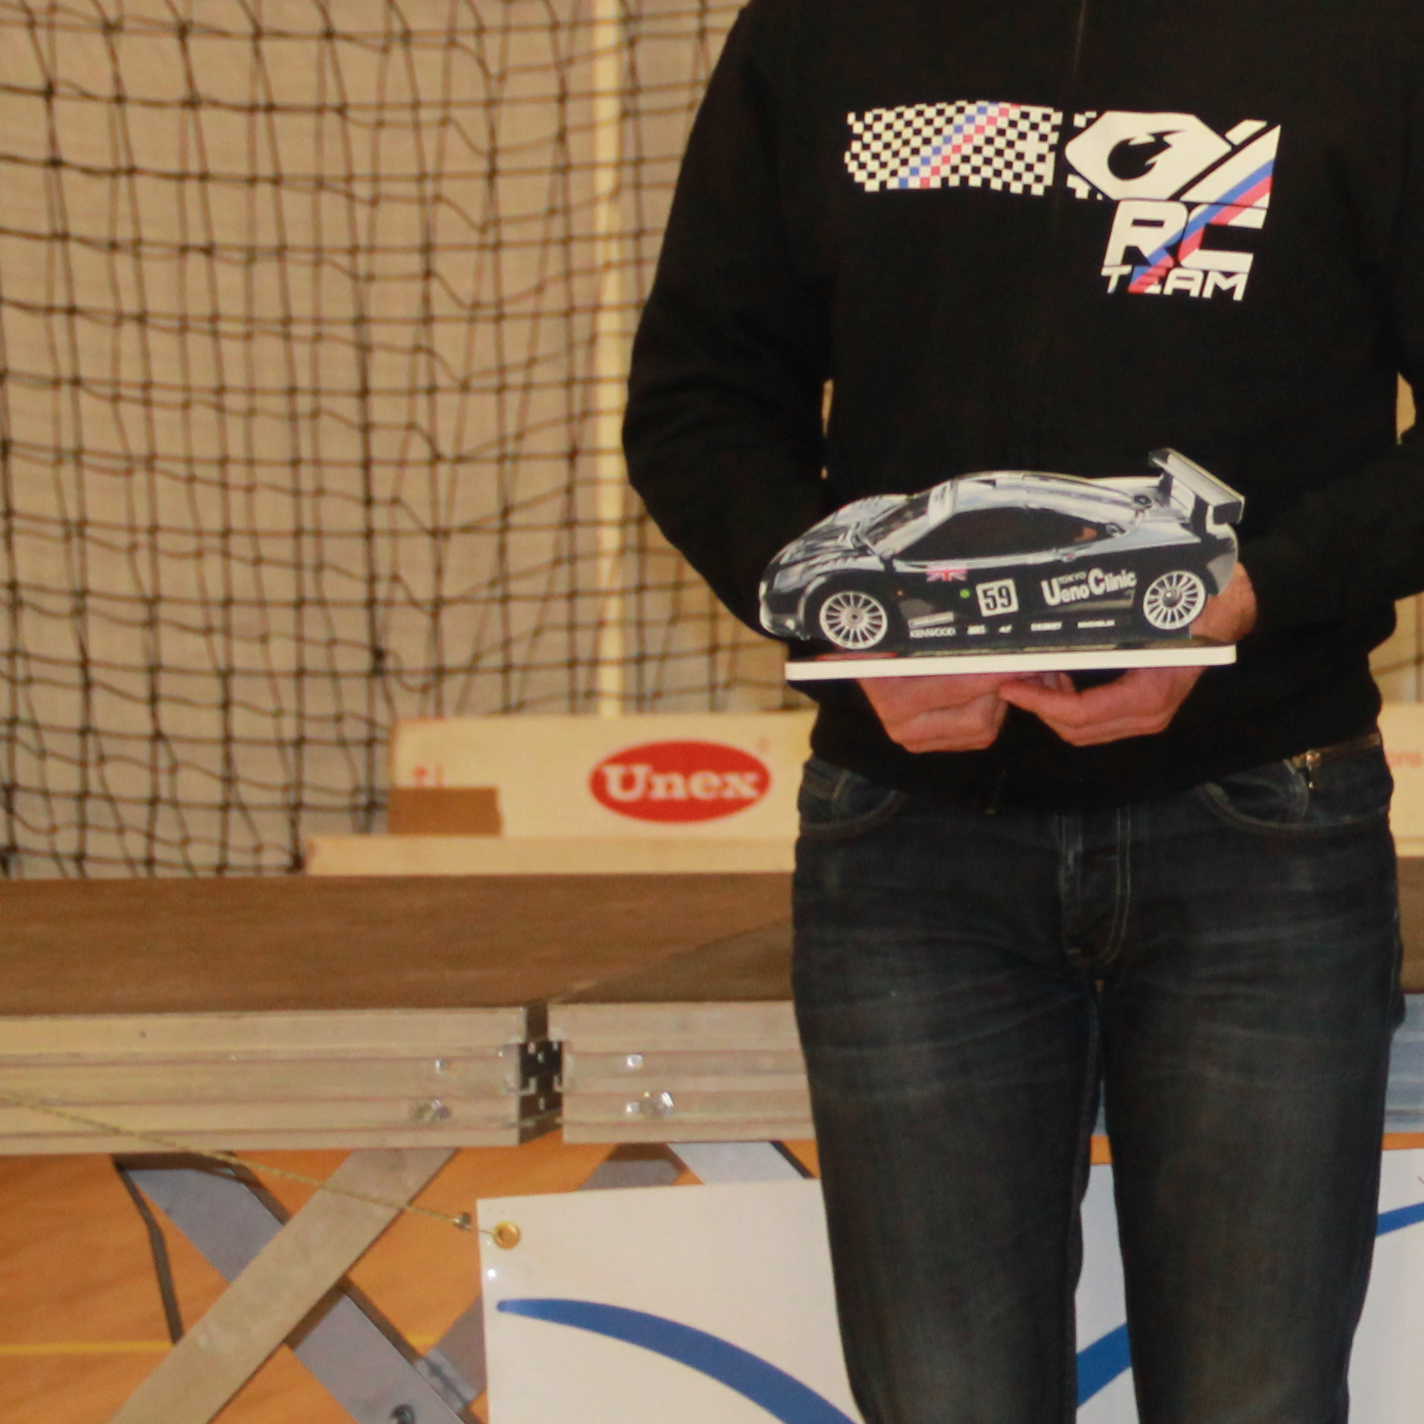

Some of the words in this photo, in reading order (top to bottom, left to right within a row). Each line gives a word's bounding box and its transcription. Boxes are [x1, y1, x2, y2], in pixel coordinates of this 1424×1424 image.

[1101, 266, 1250, 301] TEAM
[982, 585, 1014, 611] 59
[1041, 576, 1089, 606] Ueno
[1088, 568, 1138, 595] Clinic
[603, 763, 759, 802] Unex
